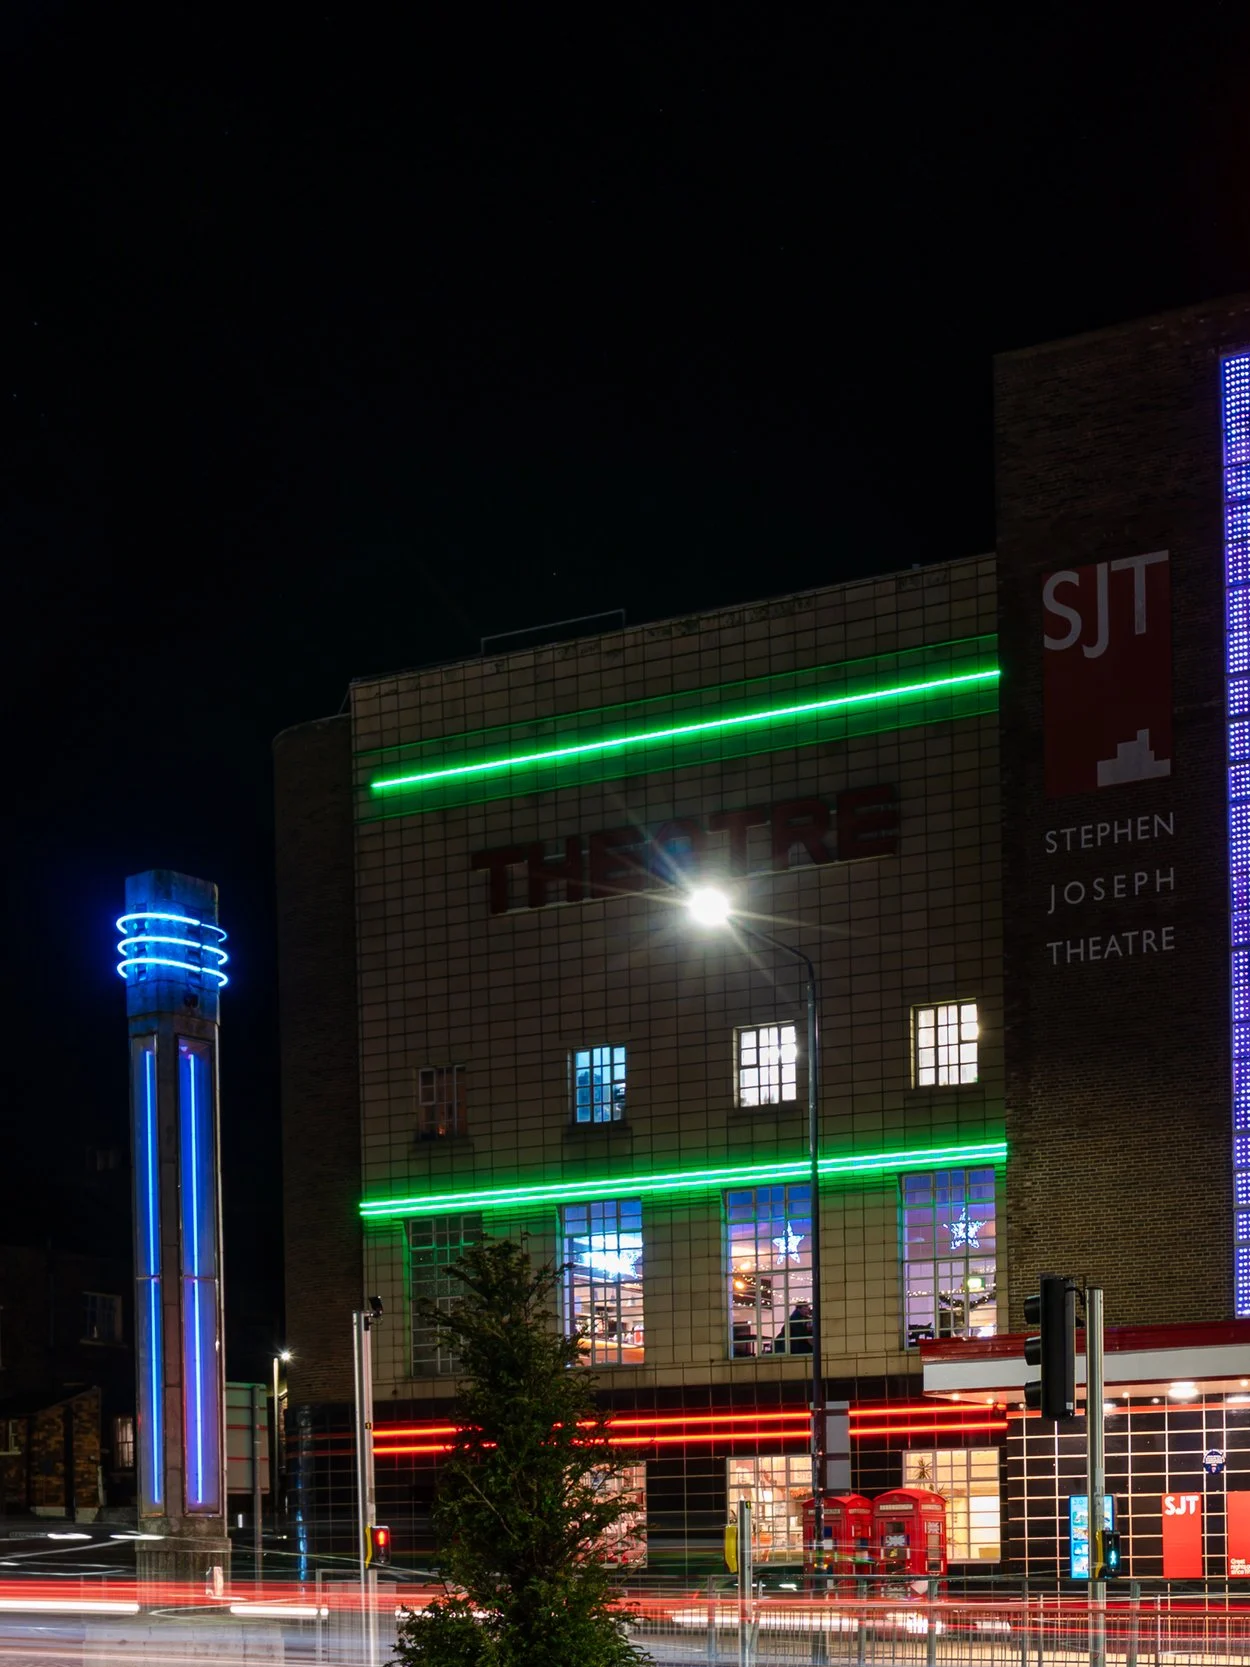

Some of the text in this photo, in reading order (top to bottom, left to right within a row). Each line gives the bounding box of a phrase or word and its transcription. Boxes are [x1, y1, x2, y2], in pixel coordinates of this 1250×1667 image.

[1042, 550, 1169, 659] SJT
[471, 782, 899, 915] THEATRE
[1045, 811, 1175, 854] STEPHEN
[1047, 867, 1176, 915] JOSEPH
[1046, 926, 1176, 966] THEATRE
[1164, 1495, 1200, 1516] SJT
